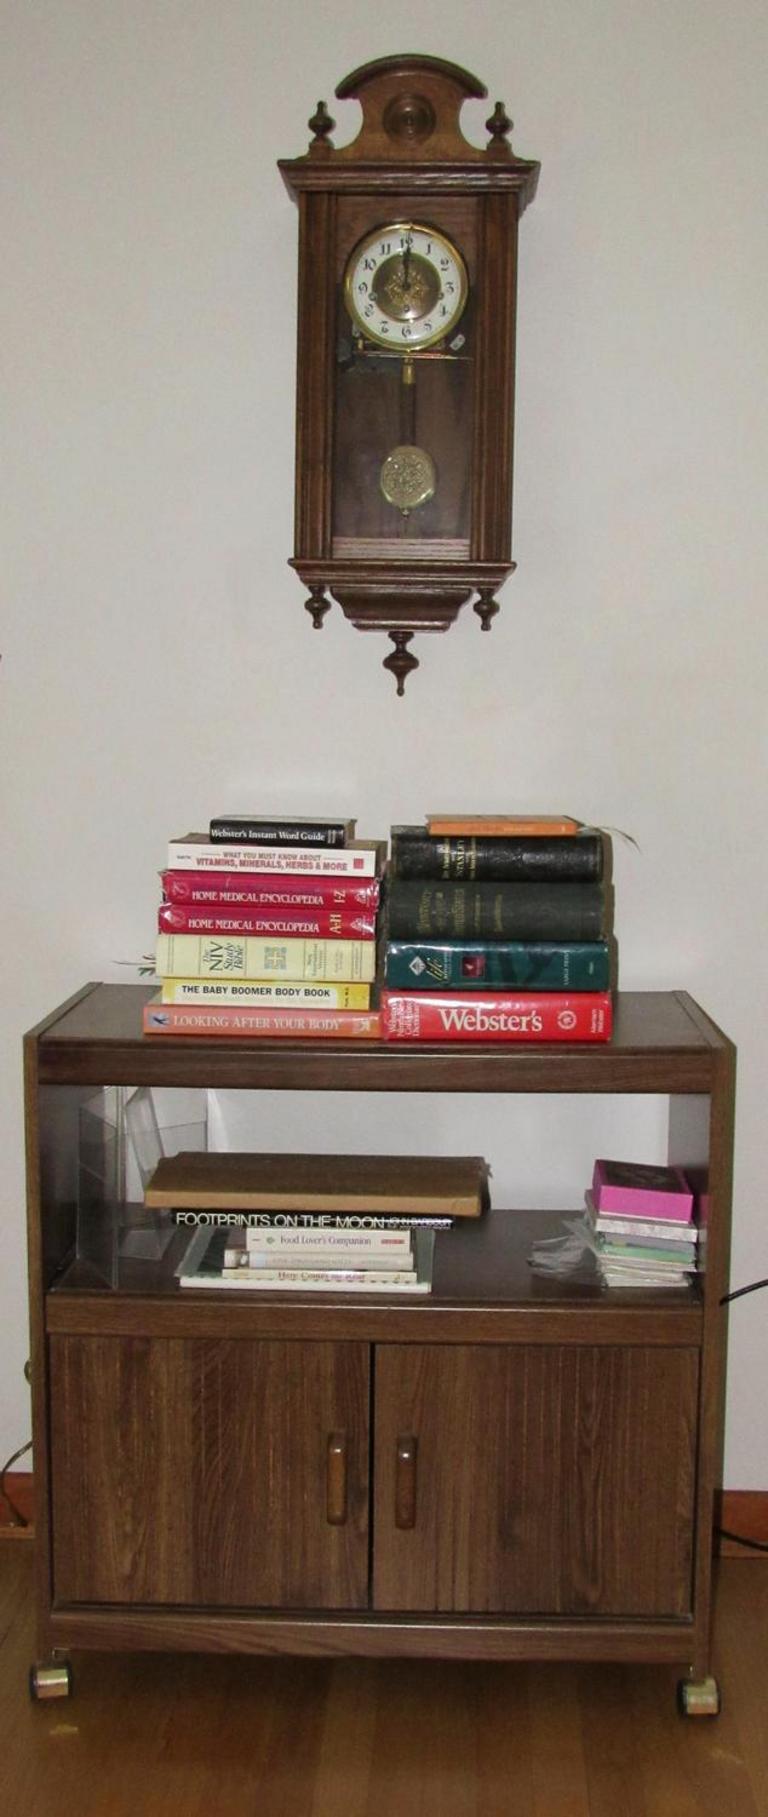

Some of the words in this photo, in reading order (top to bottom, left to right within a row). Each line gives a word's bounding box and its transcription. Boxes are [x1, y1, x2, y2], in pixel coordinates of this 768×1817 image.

[211, 828, 247, 838] Webster's
[249, 830, 277, 839] Instant
[279, 831, 299, 840] Word
[300, 832, 325, 841] Guide
[196, 858, 238, 868] VITAMINS,
[239, 859, 285, 870] MINERALS,
[286, 861, 313, 870] HERBS
[323, 862, 347, 871] MORE
[192, 891, 217, 900] HOME
[220, 892, 259, 902] MEDICAL
[260, 893, 324, 904] ENCYCLOPEDIA
[188, 918, 213, 928] HOME
[215, 919, 254, 930] MEDICAL
[256, 921, 320, 933] ENCYCLOPEDIA
[329, 914, 341, 934] A-H
[209, 941, 223, 971] NIV
[182, 985, 198, 993] THE
[203, 986, 227, 994] BABY
[231, 987, 272, 996] BOOMER
[275, 988, 301, 996] BODY
[304, 989, 330, 997] BOOK
[173, 1015, 229, 1028] LOOKING
[232, 1016, 270, 1029] AFTER
[273, 1018, 307, 1029] YOUR
[308, 1018, 341, 1030] BODY
[438, 1008, 543, 1032] Webster's
[176, 1212, 271, 1226] FOOTPRINTS
[274, 1214, 297, 1227] ON
[302, 1214, 331, 1228] THE
[335, 1216, 386, 1229] MOON
[301, 1237, 326, 1245] Lover's
[328, 1237, 371, 1247] Companion
